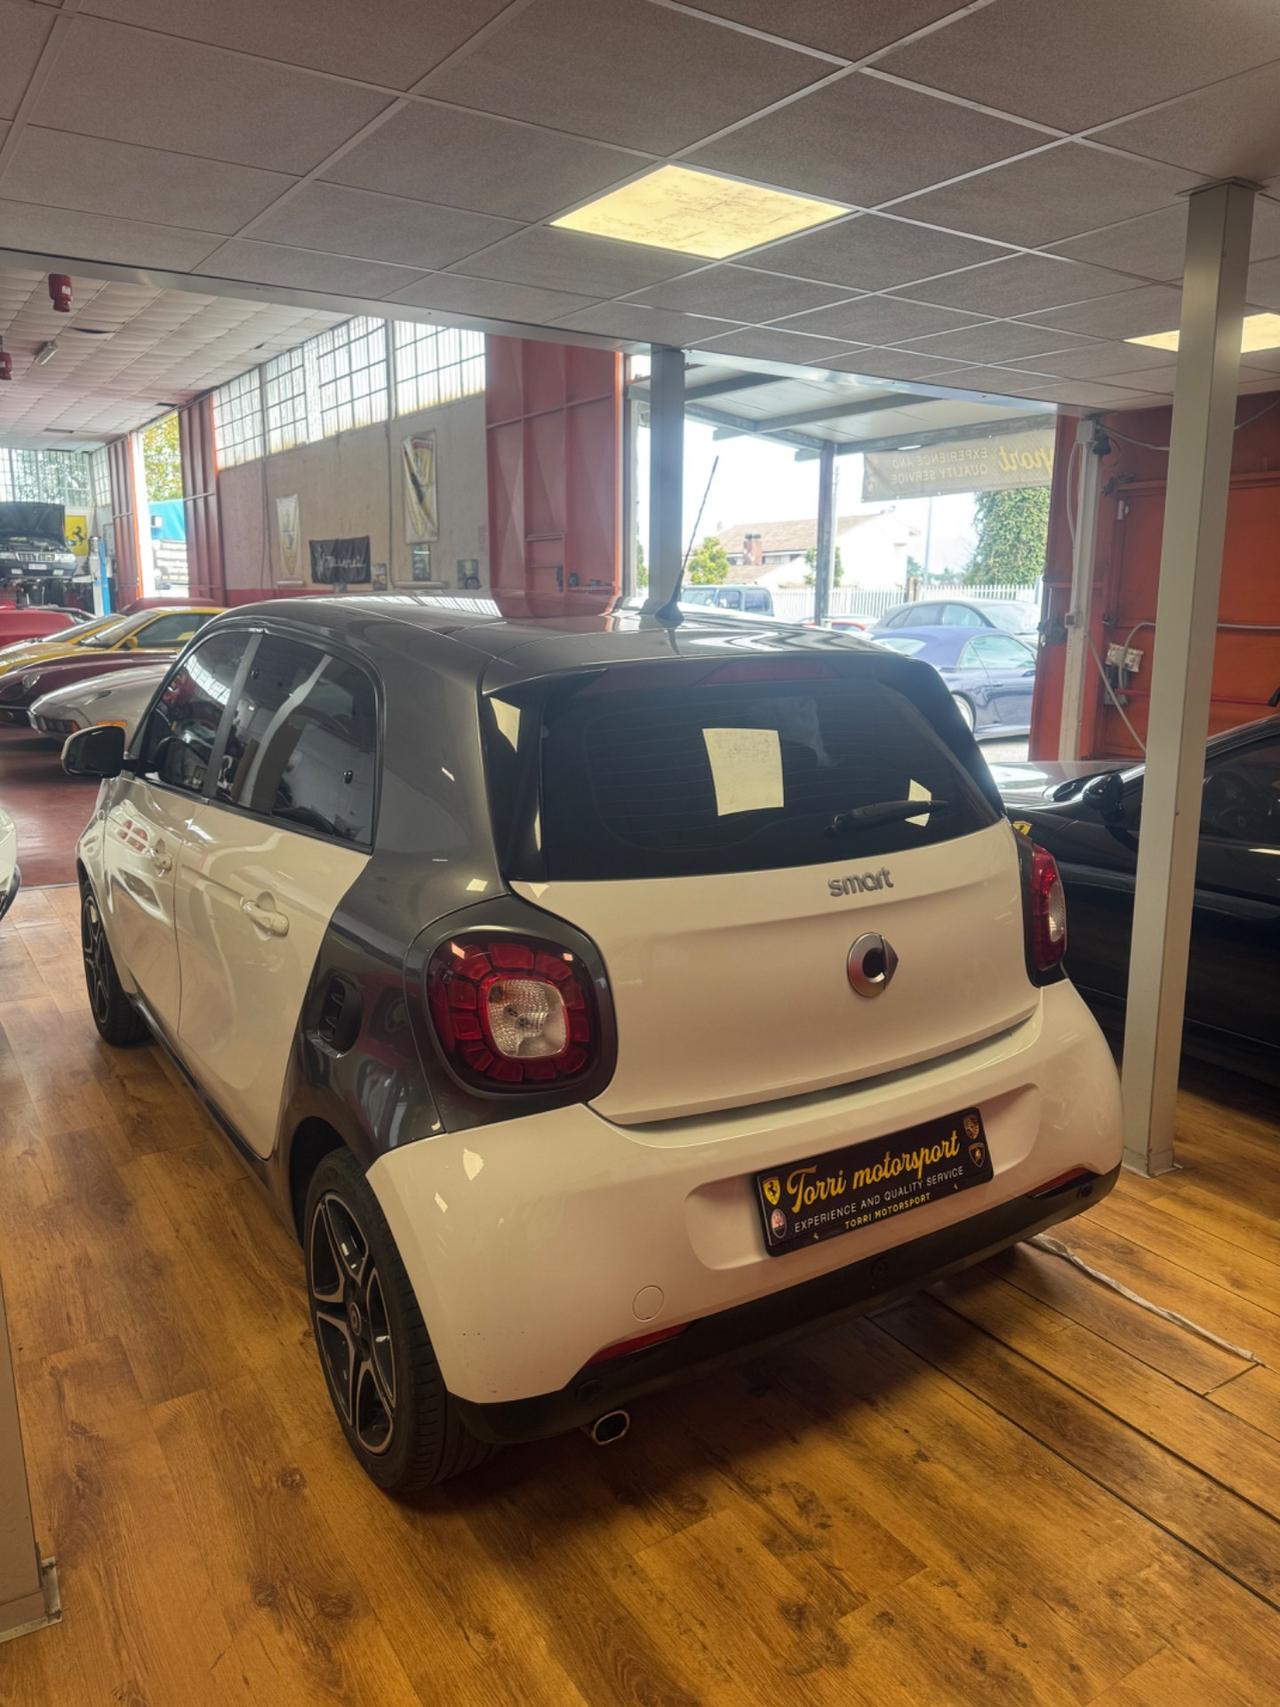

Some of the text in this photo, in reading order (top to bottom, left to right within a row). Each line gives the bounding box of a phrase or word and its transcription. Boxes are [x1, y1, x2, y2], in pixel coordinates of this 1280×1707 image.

[828, 866, 894, 897] smart
[786, 1130, 960, 1214] Torri motorsport
[794, 1165, 964, 1233] EXPERIENCE AND QUALITY SERVICE
[844, 1192, 931, 1230] TORRI MOTORSPORT
